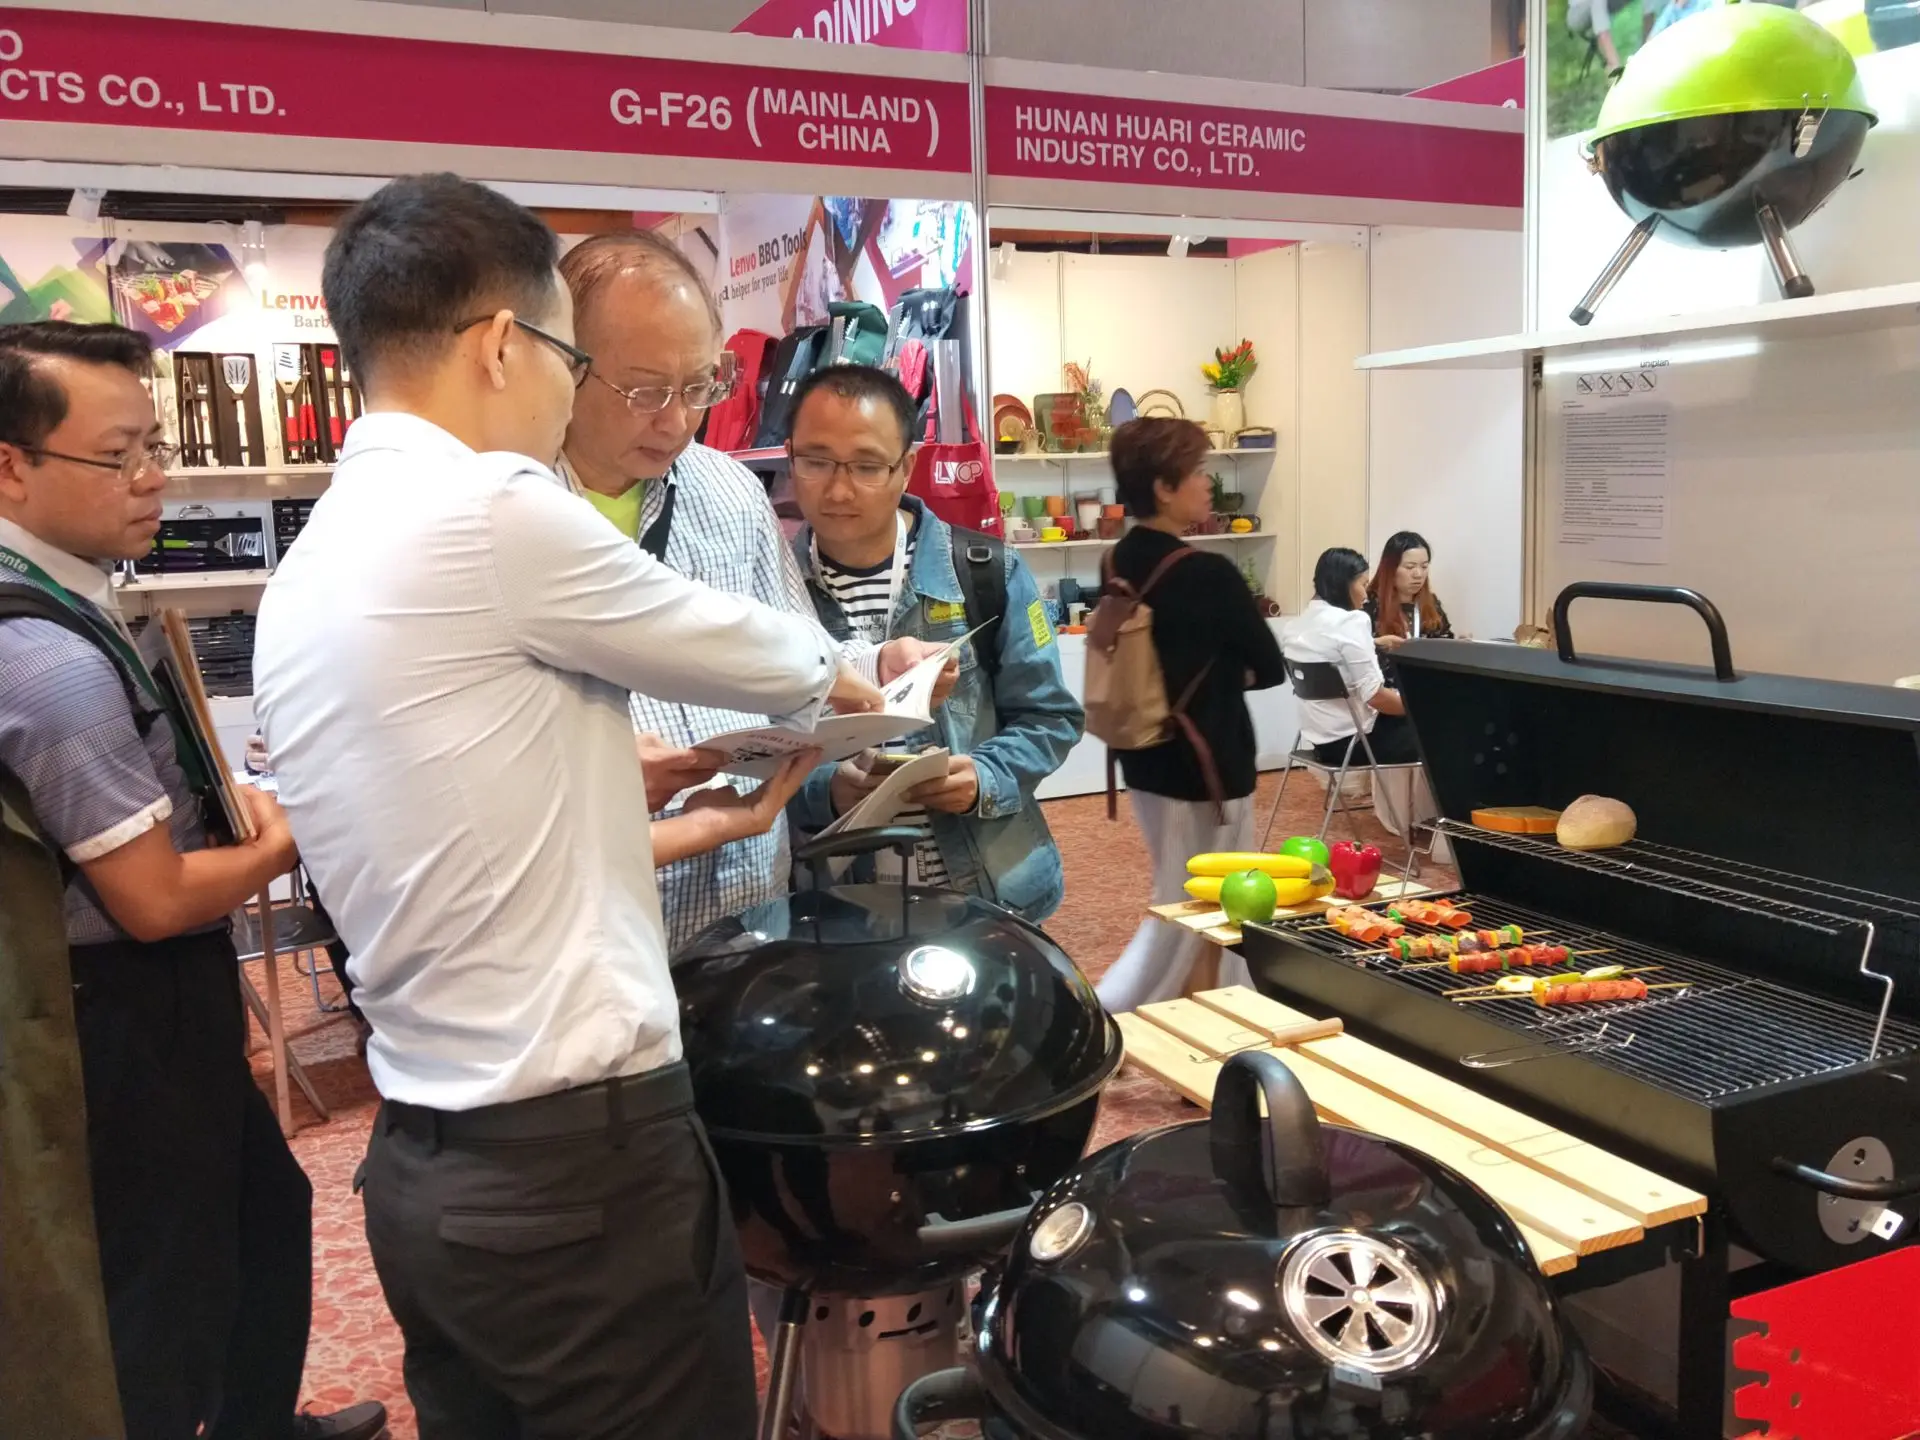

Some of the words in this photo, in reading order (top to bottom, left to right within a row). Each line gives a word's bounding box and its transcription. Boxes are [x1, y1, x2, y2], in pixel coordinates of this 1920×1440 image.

[0, 68, 86, 103] CTS
[98, 74, 185, 115] CO.,
[197, 82, 286, 116] LTD.
[609, 88, 732, 130] G-F26
[1015, 105, 1108, 137] HUNAN
[1116, 114, 1192, 144] HUARI
[1200, 121, 1306, 152] CERAMIC
[1016, 136, 1145, 169] INDUSTRY
[1153, 147, 1202, 178] CO.,
[1209, 151, 1260, 177] LTD.
[730, 252, 757, 278] Lenvo
[758, 238, 780, 267] BBQ
[781, 227, 808, 258] Tools
[731, 281, 751, 300] helper
[752, 276, 761, 291] for
[761, 273, 777, 293] your
[777, 265, 789, 283] life
